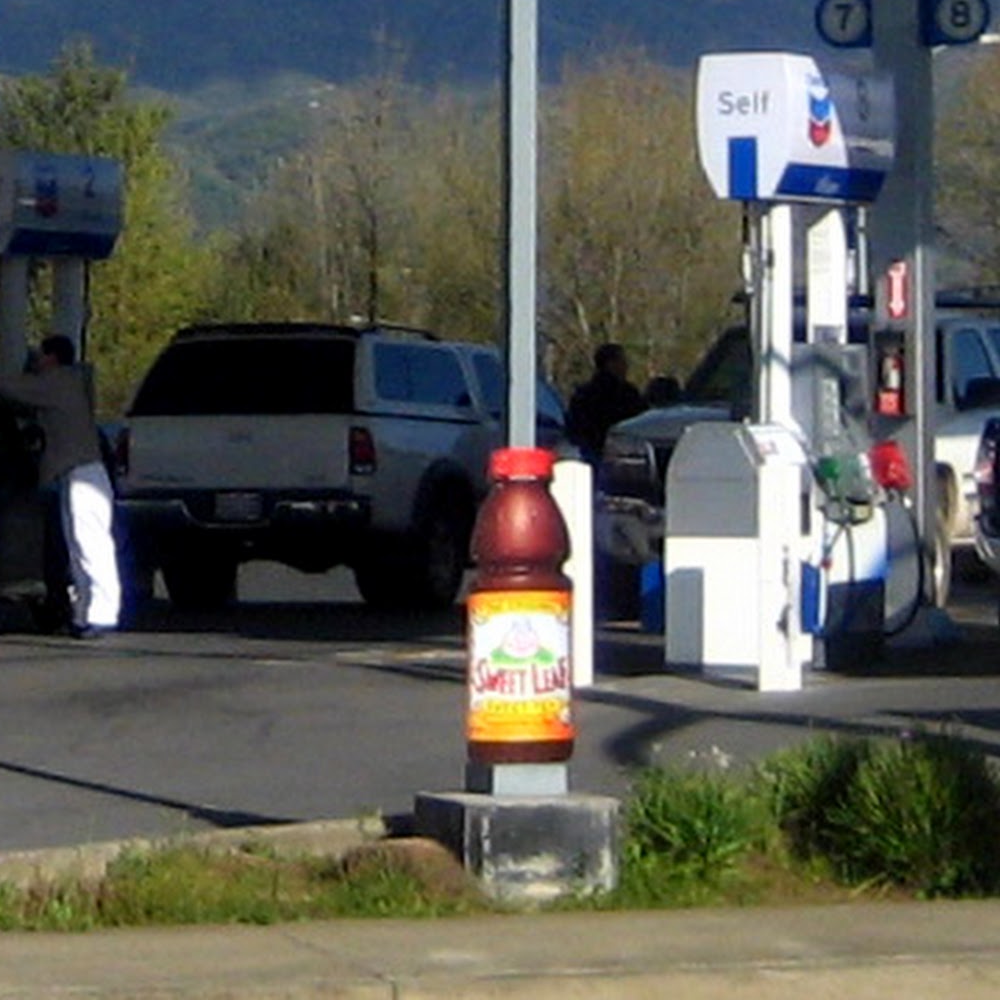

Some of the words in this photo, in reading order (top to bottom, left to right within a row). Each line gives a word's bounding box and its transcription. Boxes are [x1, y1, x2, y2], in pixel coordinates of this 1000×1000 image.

[834, 2, 855, 30] 7
[949, 1, 970, 27] 8
[717, 91, 770, 115] Self
